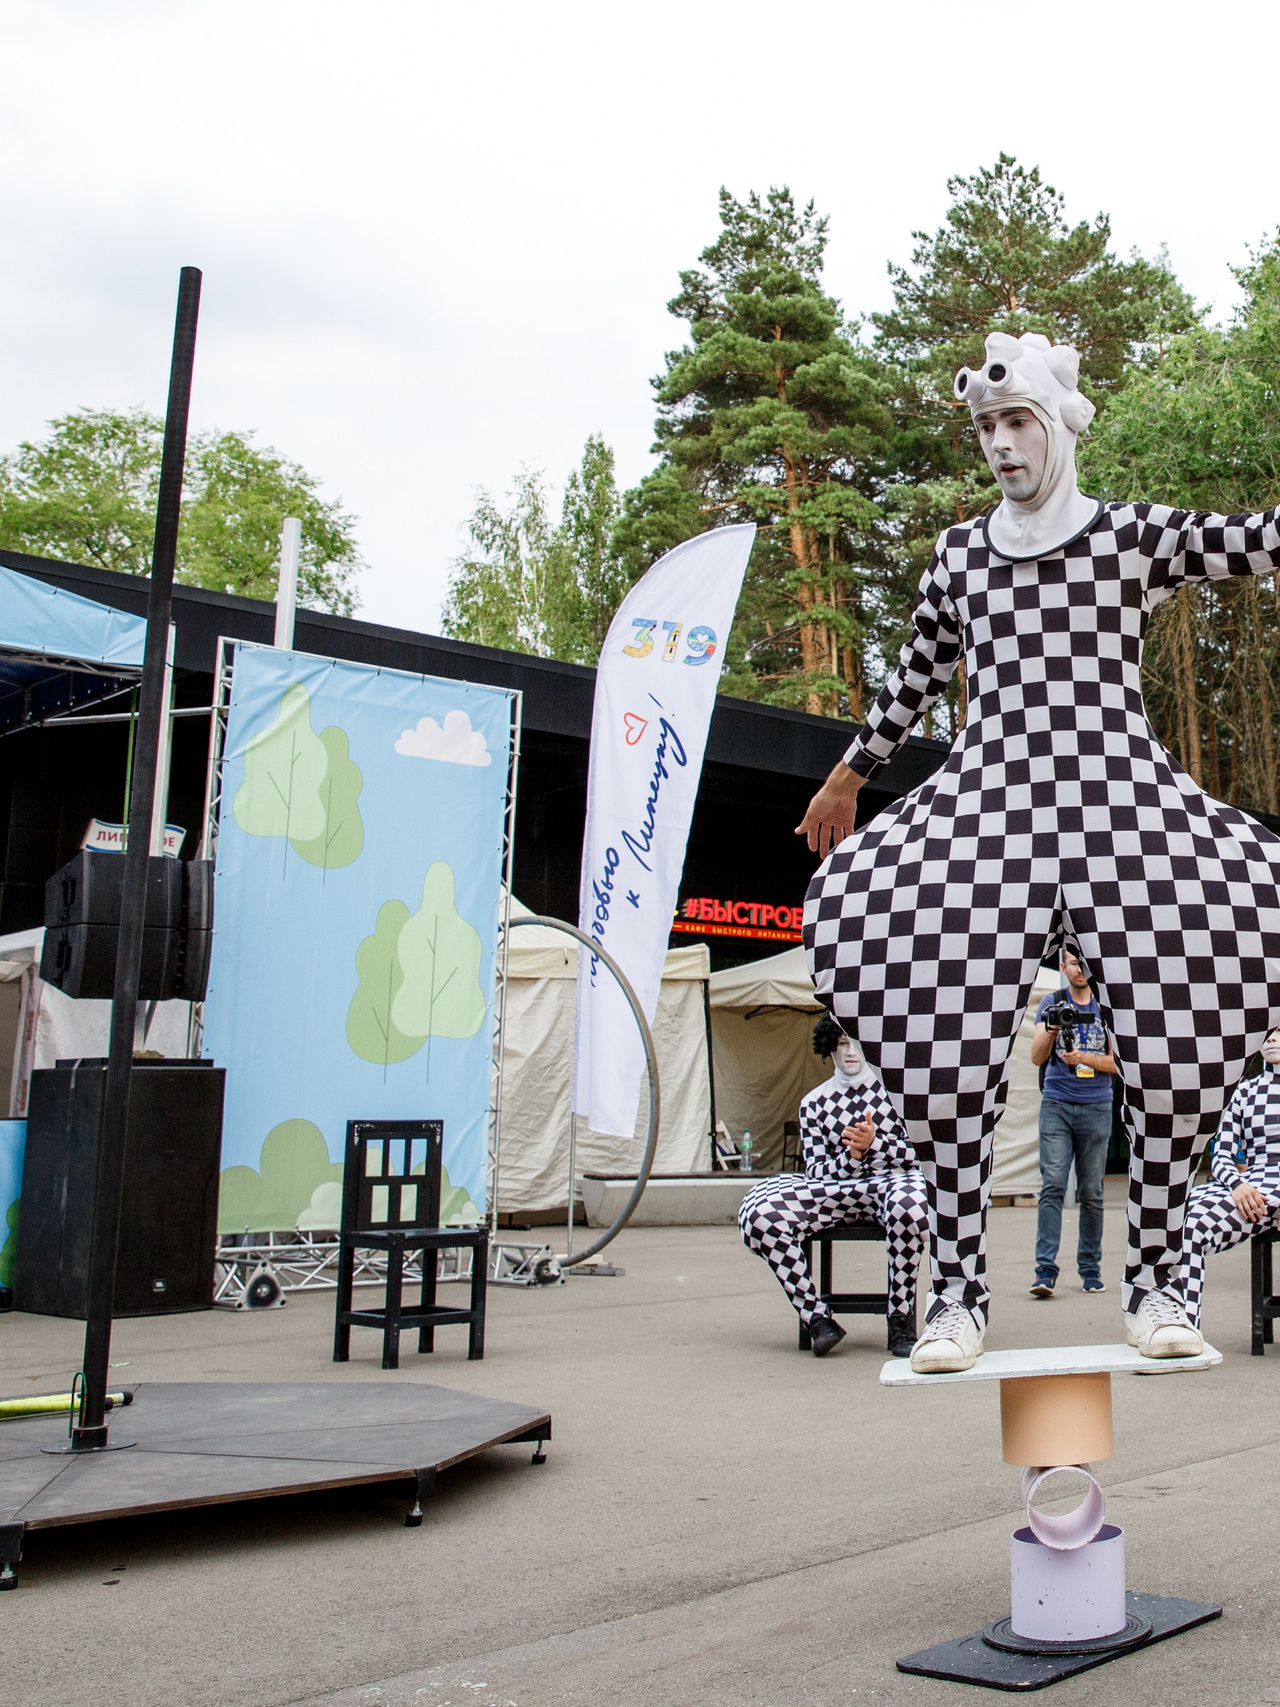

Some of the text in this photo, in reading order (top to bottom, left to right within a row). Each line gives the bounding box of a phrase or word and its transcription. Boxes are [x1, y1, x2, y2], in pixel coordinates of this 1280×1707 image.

[621, 617, 717, 667] 319
[621, 692, 688, 872] Липецку!
[685, 924, 791, 939] КАФЕ БЫСТРОГО ПИТАНИЯ
